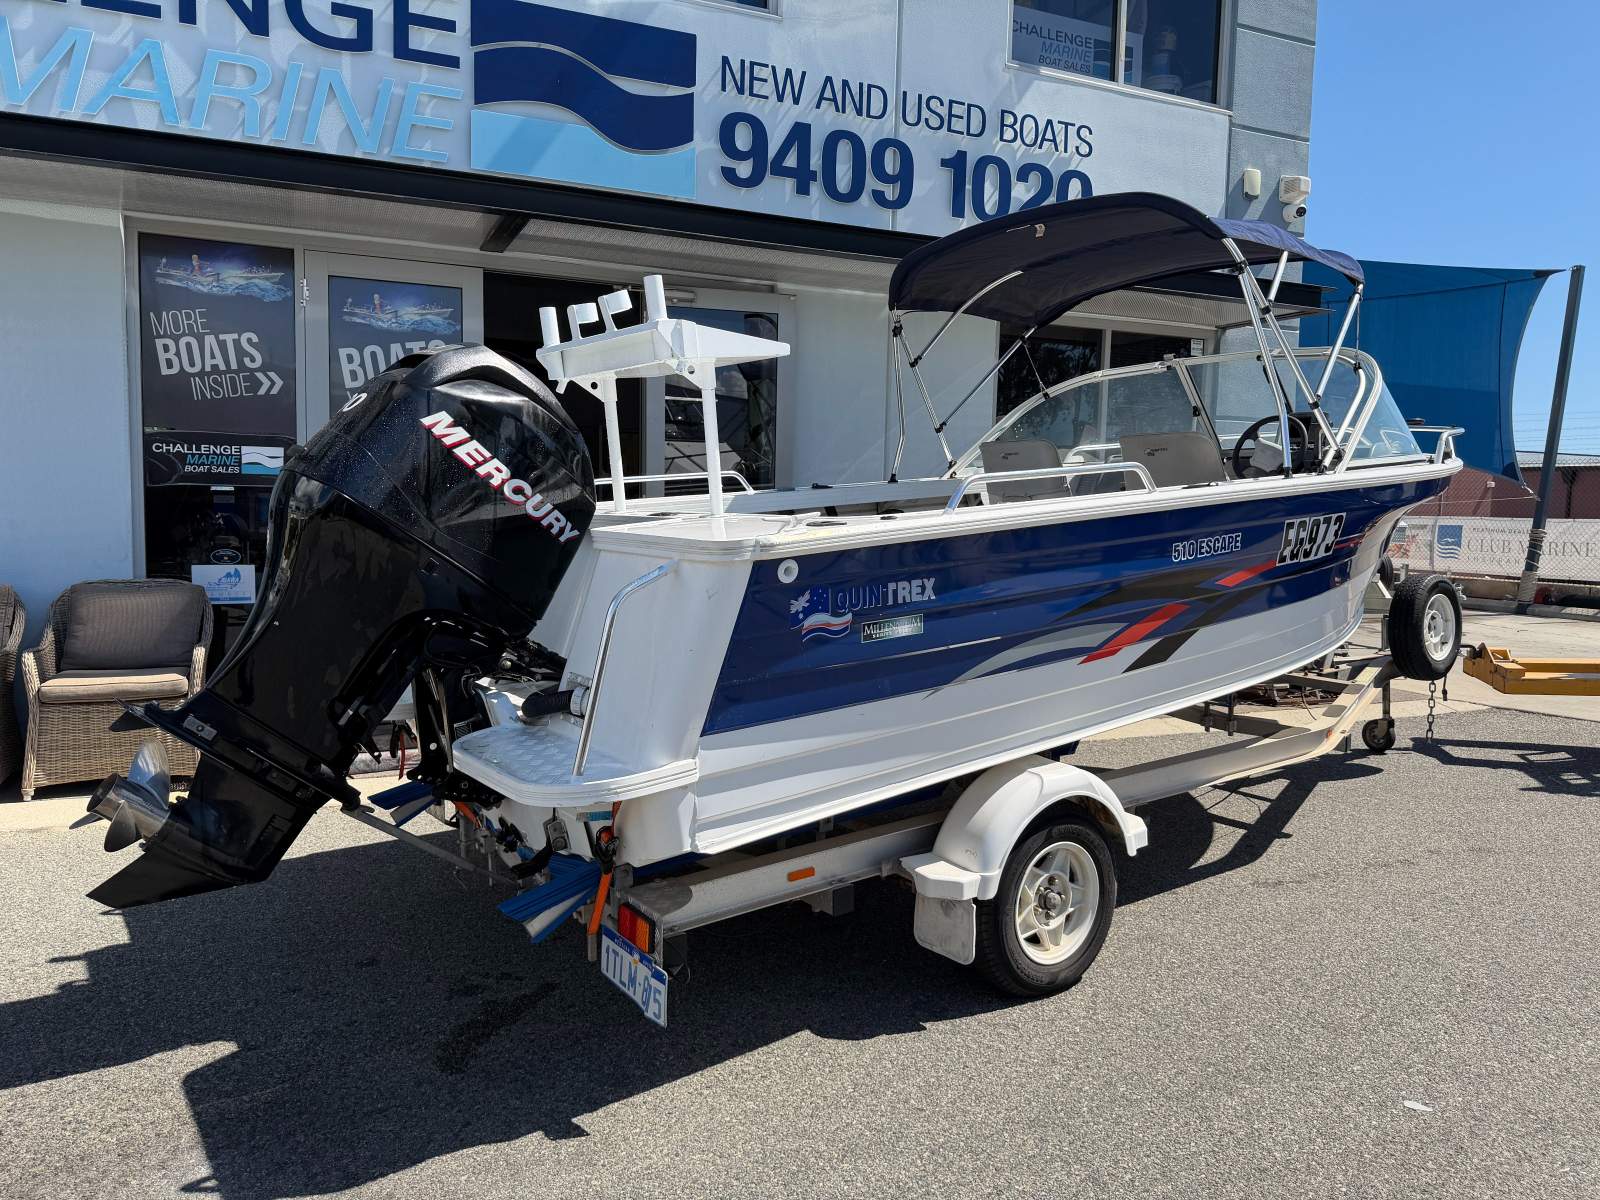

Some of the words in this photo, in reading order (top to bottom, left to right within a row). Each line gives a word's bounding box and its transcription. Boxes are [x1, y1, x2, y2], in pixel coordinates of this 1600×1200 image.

[1012, 20, 1093, 48] CHALLENGE
[1038, 54, 1064, 68] BOAT
[1063, 59, 1090, 73] SALES
[1040, 41, 1092, 63] MARINE
[721, 56, 807, 103] NEW
[816, 75, 888, 120] AND
[902, 92, 987, 138] USED
[1000, 109, 1093, 158] BOATS
[718, 112, 914, 209] 9409
[150, 309, 209, 336] MORE
[155, 332, 262, 375] BOATS
[191, 372, 253, 400] INSIDE
[152, 443, 241, 455] CHALLENGE
[186, 454, 239, 466] MARINE
[184, 465, 210, 473] BOAT
[210, 466, 240, 474] SALES
[419, 410, 580, 544] MERCURY
[1172, 541, 1195, 562] 510
[1197, 532, 1242, 558] ESCAPE
[1276, 512, 1346, 566] EG973
[1466, 539, 1512, 554] CLUB
[1517, 541, 1597, 558] MRINE
